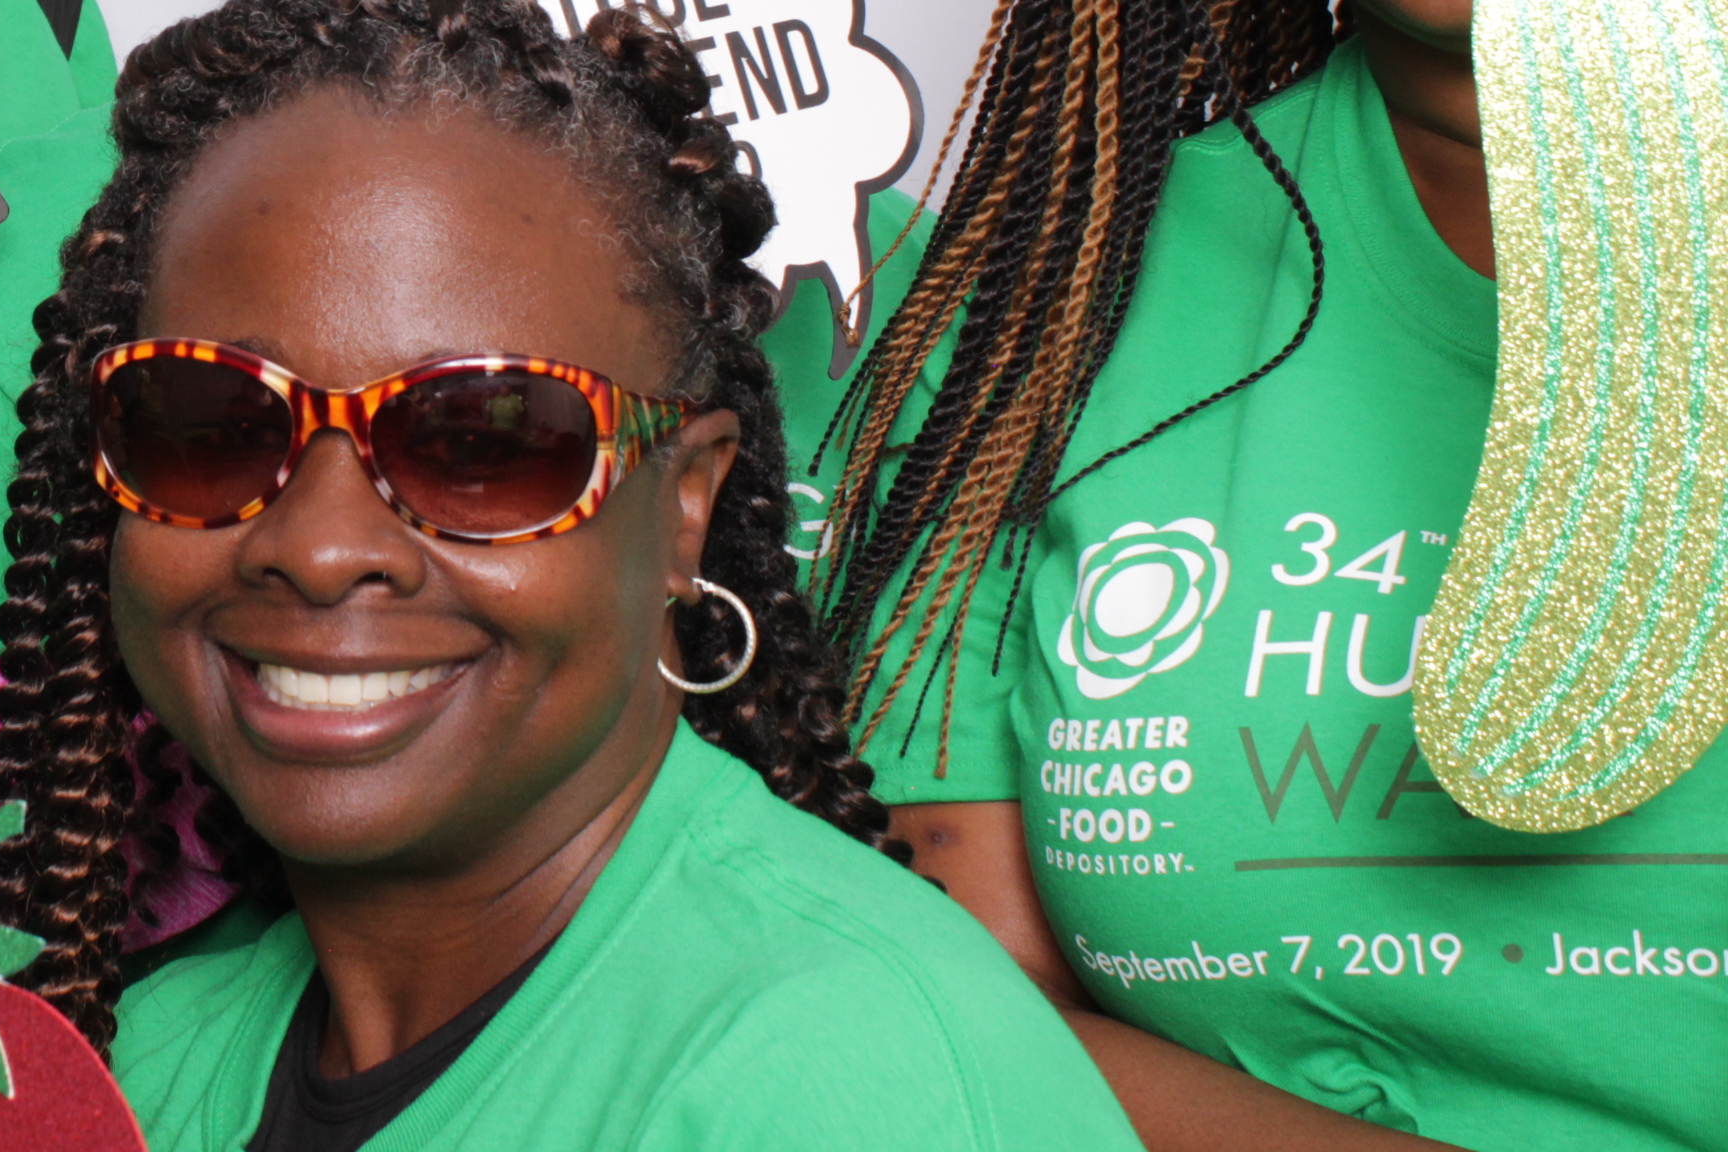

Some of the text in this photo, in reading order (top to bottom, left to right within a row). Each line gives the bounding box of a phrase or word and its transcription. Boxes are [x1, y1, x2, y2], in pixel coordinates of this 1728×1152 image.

[1047, 715, 1190, 752] GREATER
[1040, 759, 1194, 797] CHICAGO
[1074, 933, 1269, 990] September
[1280, 935, 1324, 981] 7,
[1336, 932, 1463, 977] 2019
